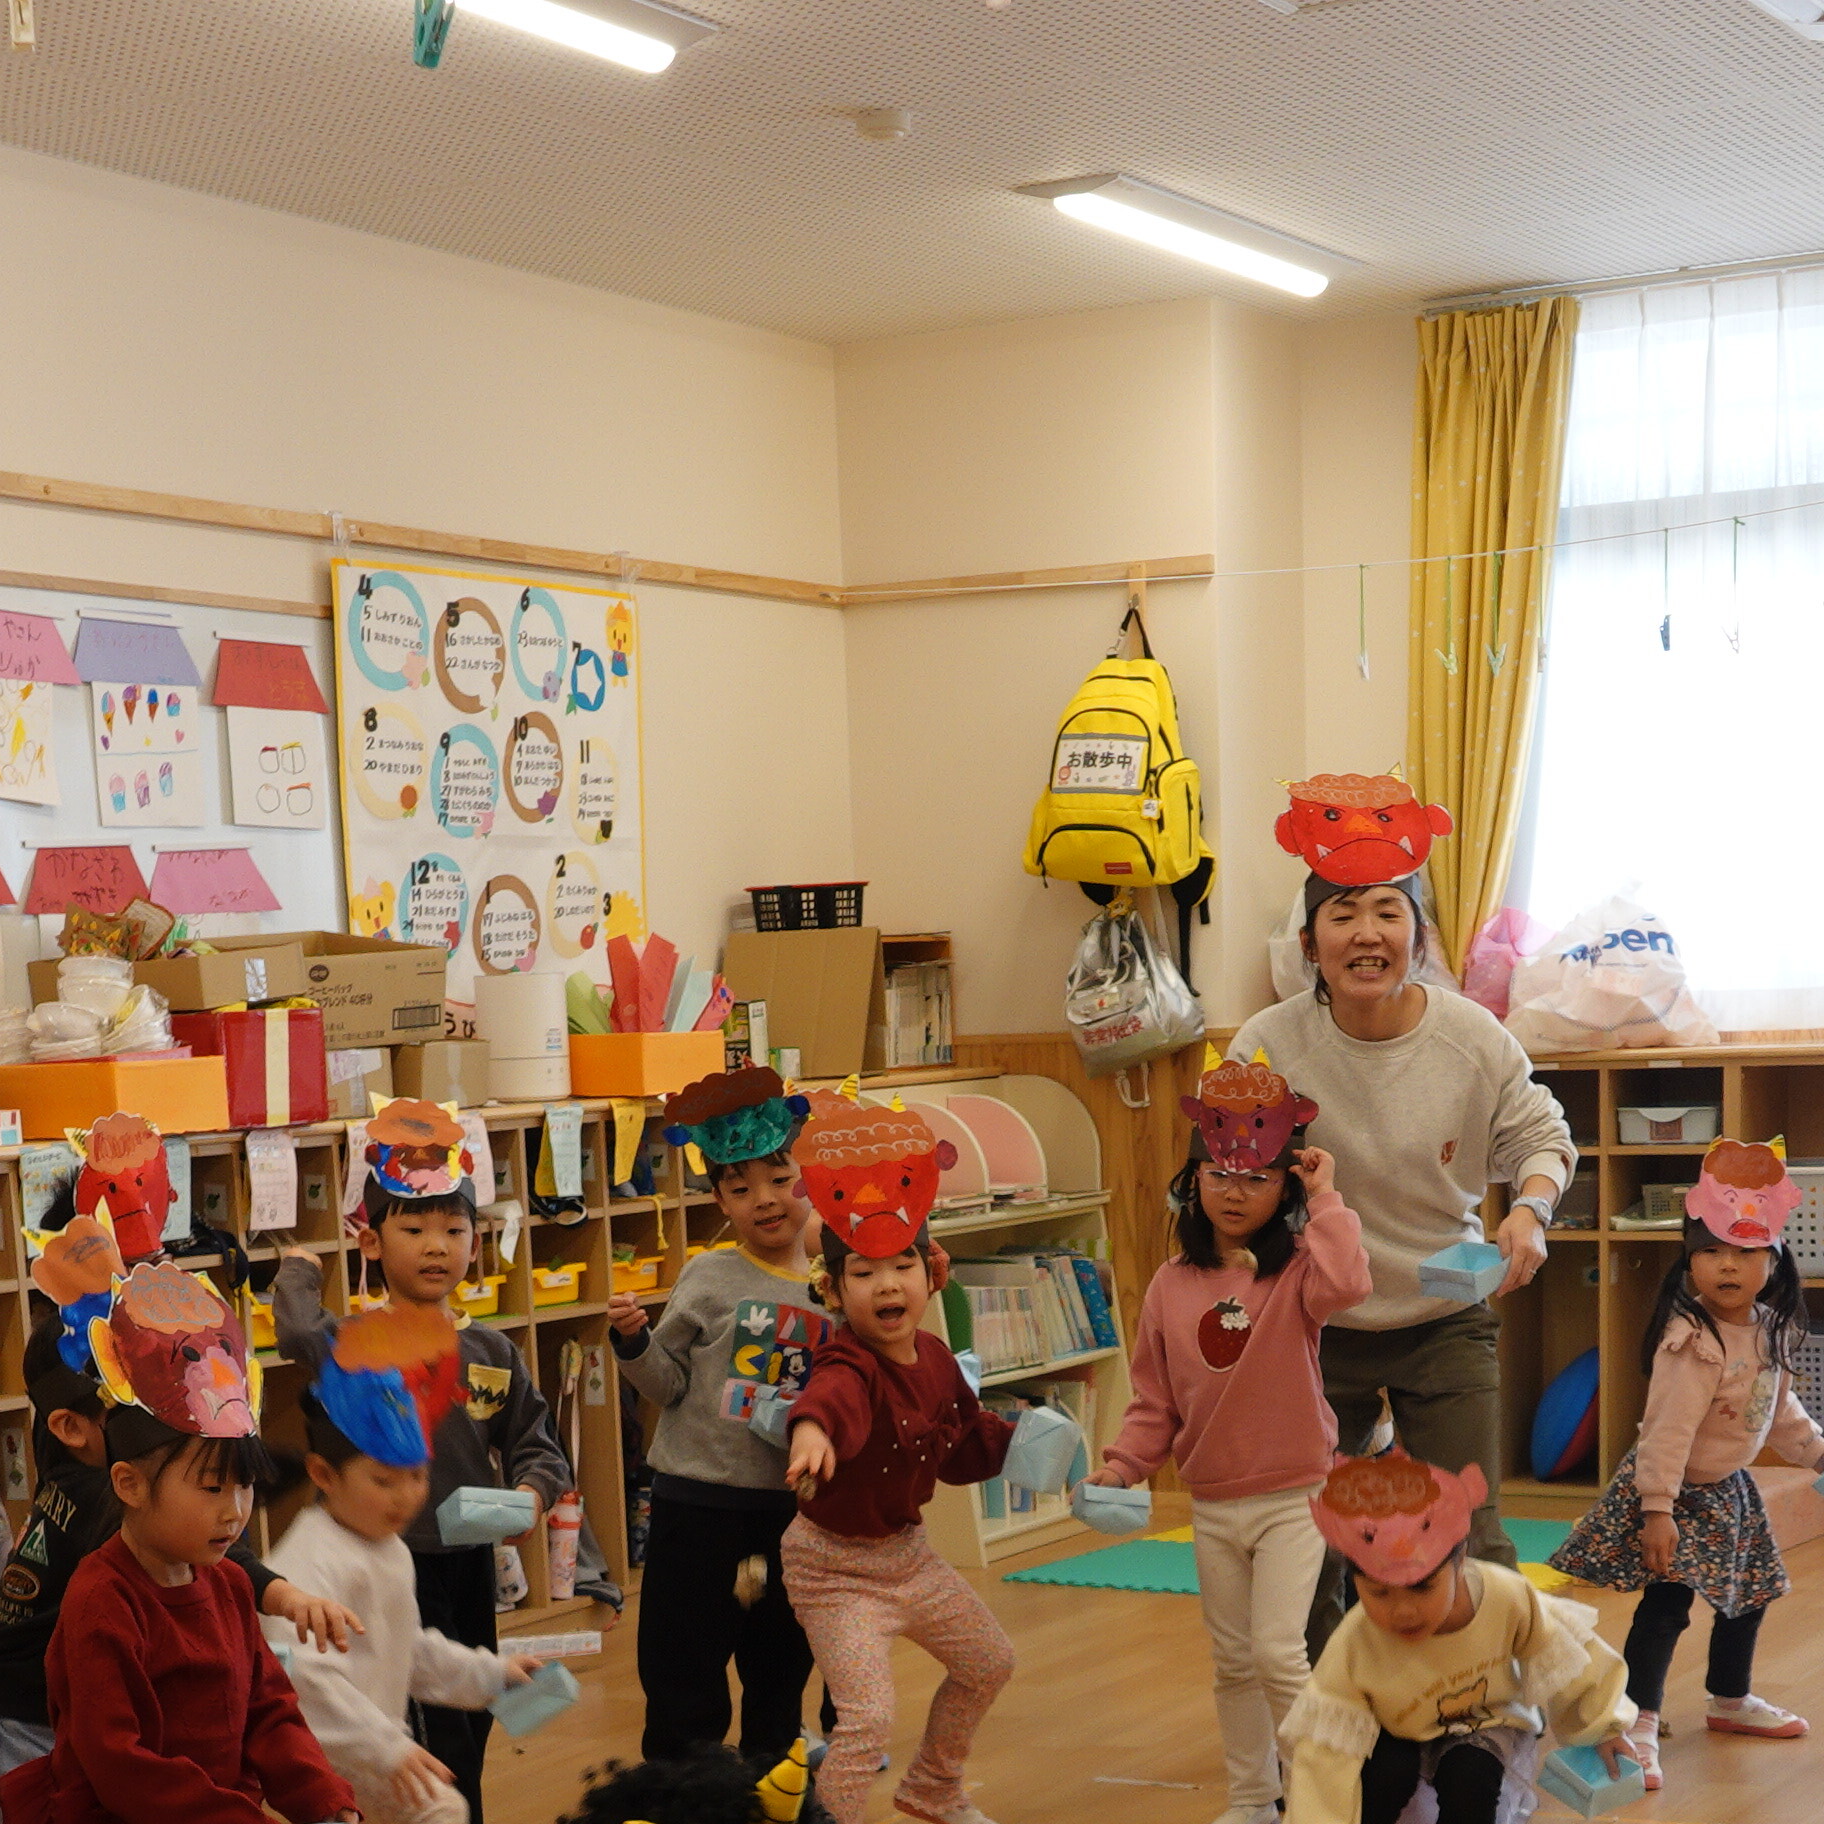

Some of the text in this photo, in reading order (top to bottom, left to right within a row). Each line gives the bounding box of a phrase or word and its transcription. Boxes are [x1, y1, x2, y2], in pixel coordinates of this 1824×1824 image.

[358, 574, 373, 600] 4
[520, 586, 530, 613] 6
[363, 604, 373, 621] 5
[446, 601, 460, 628] 5
[360, 626, 371, 643] 11
[445, 632, 457, 648] 16
[572, 640, 582, 666] 7
[362, 706, 378, 732] 8
[514, 715, 529, 742] 10
[365, 735, 375, 751] 2
[440, 732, 451, 757] 9
[580, 739, 590, 764] 11
[1066, 752, 1133, 769] お散歩中
[411, 859, 430, 886] 12
[555, 853, 566, 878] 2
[603, 892, 612, 917] 3
